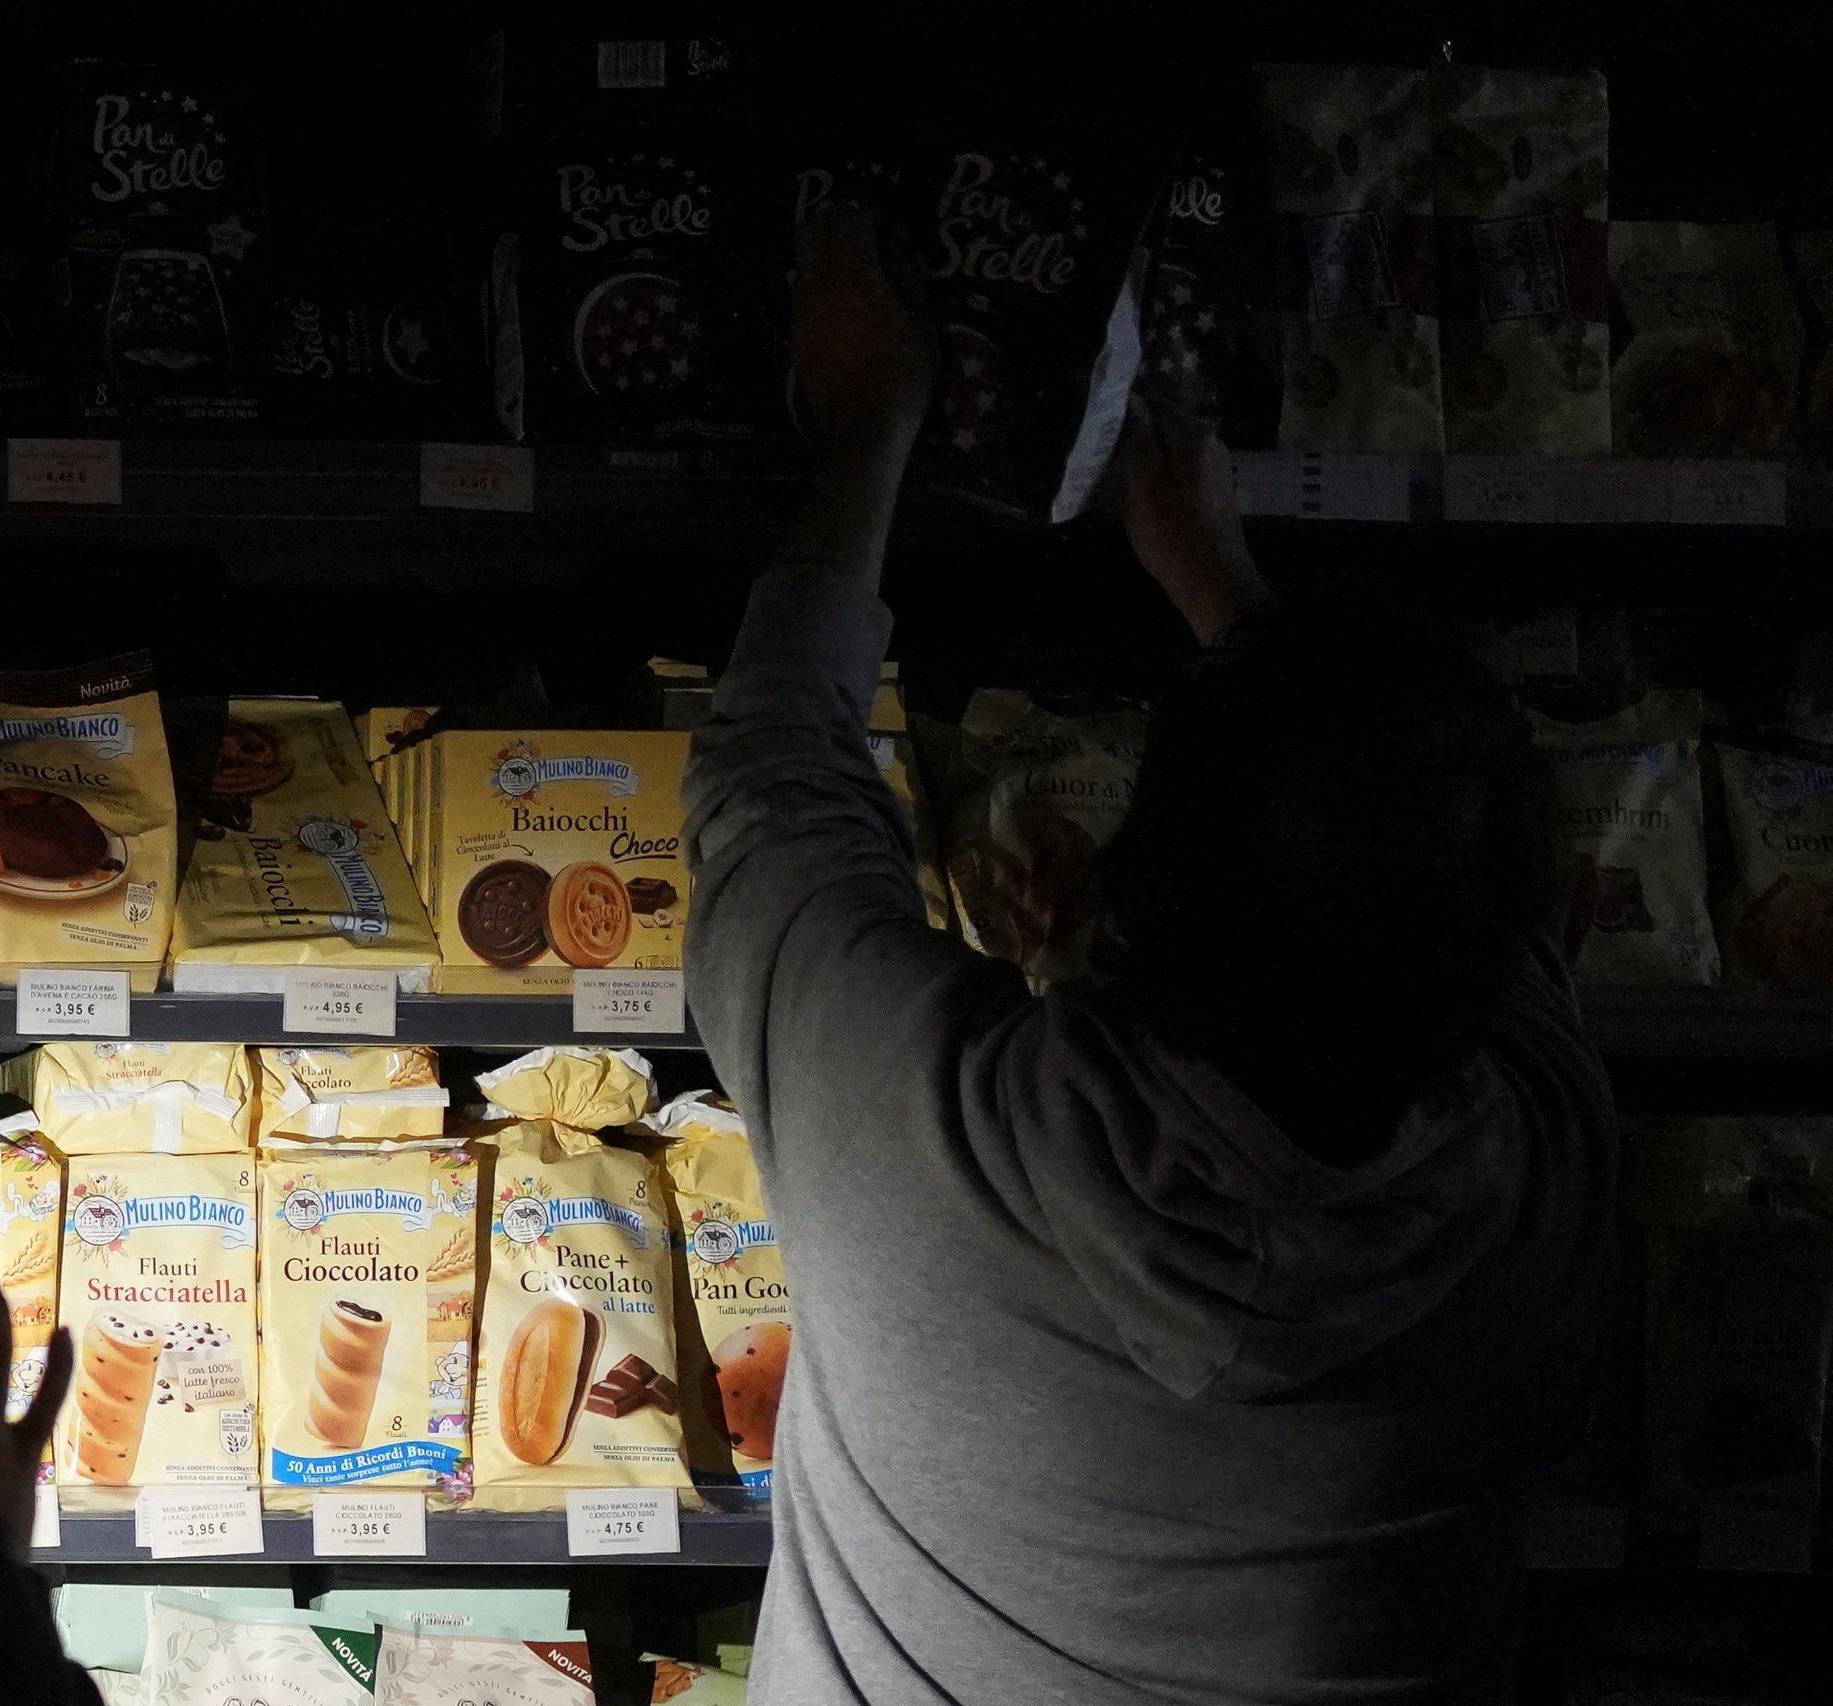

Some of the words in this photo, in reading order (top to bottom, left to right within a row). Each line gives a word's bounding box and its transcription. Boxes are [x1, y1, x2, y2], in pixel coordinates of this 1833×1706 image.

[93, 94, 157, 154] Pan
[90, 150, 228, 203] Stelle
[555, 163, 634, 210] Pan
[559, 193, 714, 254] Stelle
[923, 222, 1078, 294] Stelle
[80, 676, 132, 699] Novità
[512, 806, 629, 832] Baiocchi
[610, 831, 679, 860] Choco
[247, 836, 314, 927] Baiocchi
[56, 1003, 87, 1016] 3,95
[88, 1004, 96, 1015] €
[323, 1003, 351, 1015] 4,95
[612, 1000, 639, 1013] 3,75
[238, 1170, 250, 1188] 8
[125, 1196, 187, 1225] MULINO
[190, 1195, 245, 1226] BIANCO
[325, 1191, 372, 1215] MULINO
[376, 1191, 422, 1214] BIANCO
[549, 1196, 602, 1224] MULINO
[320, 1236, 381, 1257] Flauti
[555, 1243, 610, 1268] Pane
[138, 1257, 198, 1277] Flauti
[283, 1258, 419, 1284] Cioccolato
[88, 1278, 248, 1304] Stracciatella
[520, 1268, 653, 1296] Cioccolato
[693, 1276, 738, 1303] Pan
[602, 1298, 617, 1313] al
[621, 1298, 656, 1315] latte
[208, 1363, 234, 1375] 100%
[184, 1377, 208, 1388] latte
[210, 1376, 240, 1389] fresco
[194, 1389, 236, 1401] italiano
[287, 1460, 304, 1475] 50
[306, 1461, 336, 1476] Anni
[342, 1457, 354, 1471] di
[356, 1445, 404, 1469] Ricordi
[408, 1443, 447, 1460] Buoni
[188, 1523, 215, 1536] 3,95
[350, 1522, 378, 1535] 3,95
[605, 1522, 632, 1536] 4,75
[331, 1636, 374, 1684] NOVITÀ
